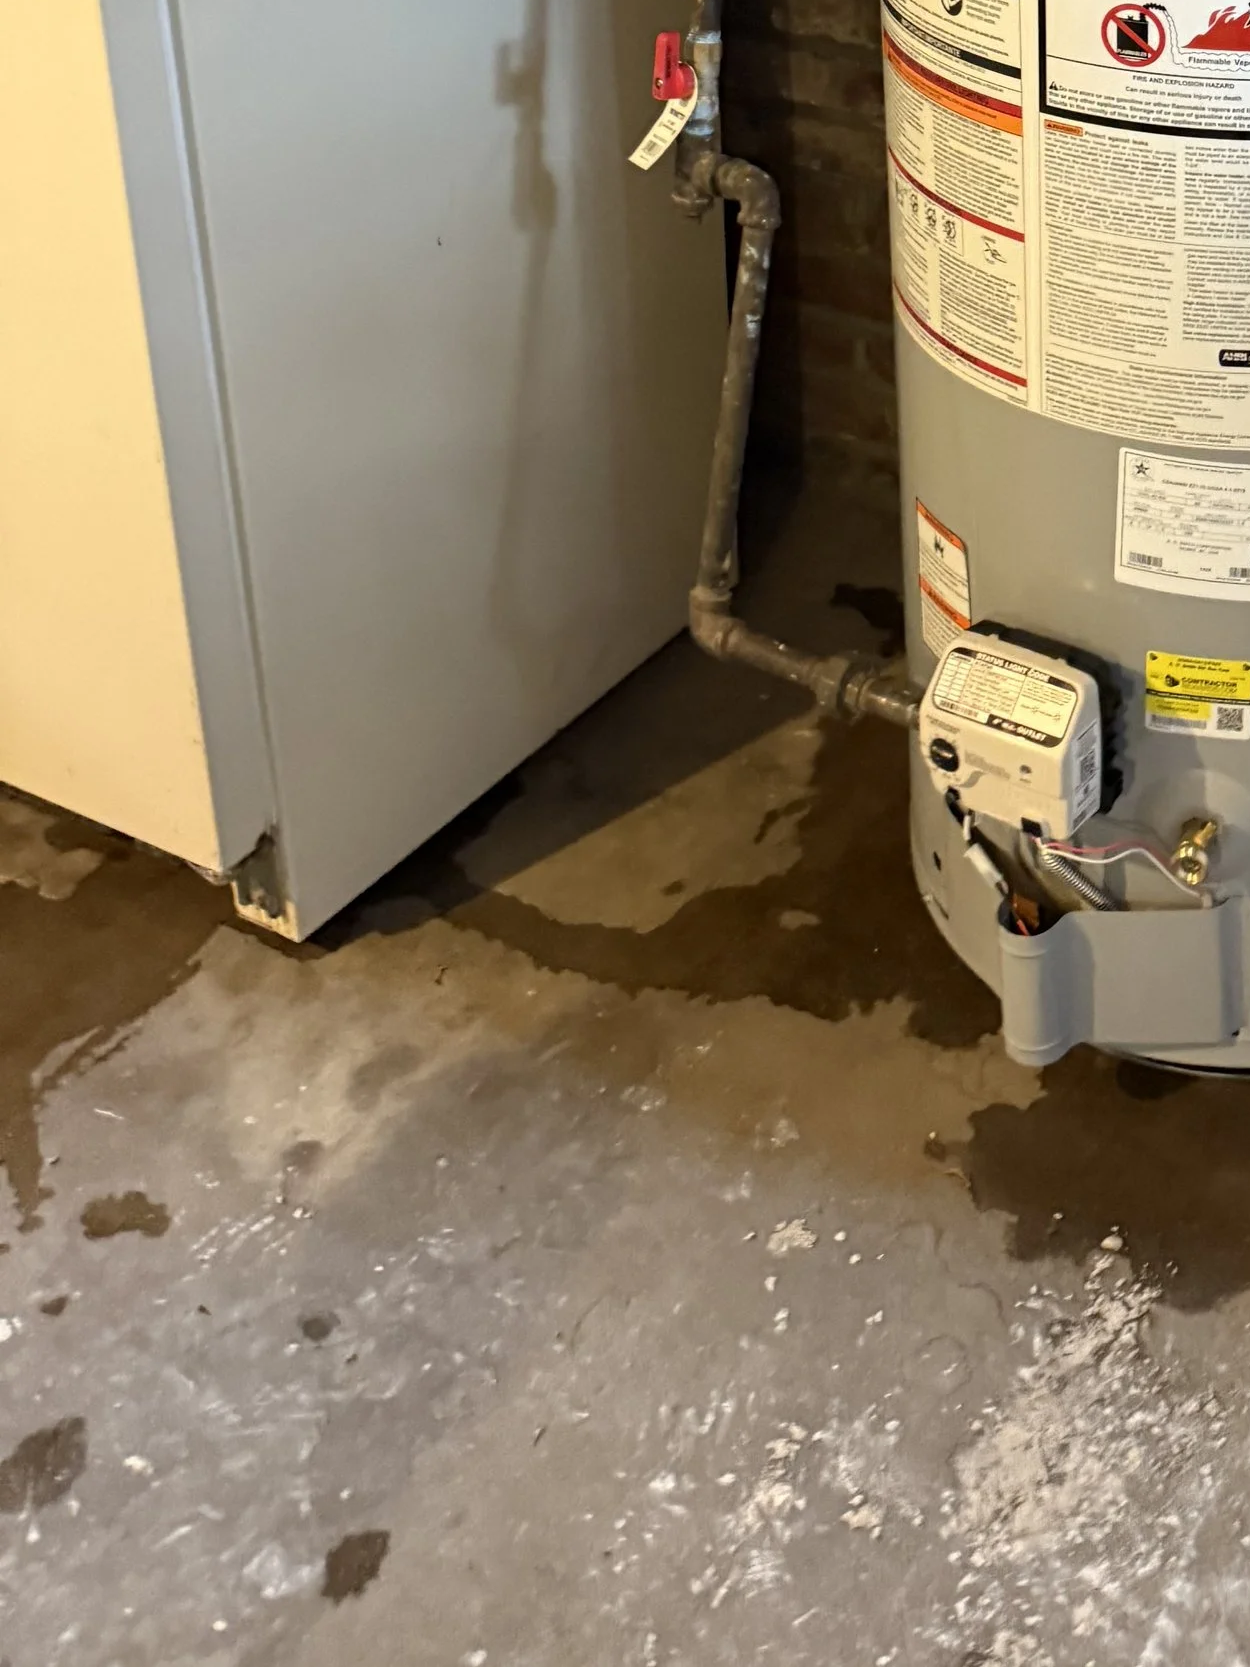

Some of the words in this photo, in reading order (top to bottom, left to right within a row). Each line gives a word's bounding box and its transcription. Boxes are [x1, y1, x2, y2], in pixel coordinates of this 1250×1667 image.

[1188, 56, 1231, 66] Flammable
[1140, 88, 1158, 96] result
[976, 653, 1004, 667] STATUS
[1005, 661, 1028, 674] LIGHT
[1017, 726, 1046, 742] OUTLET
